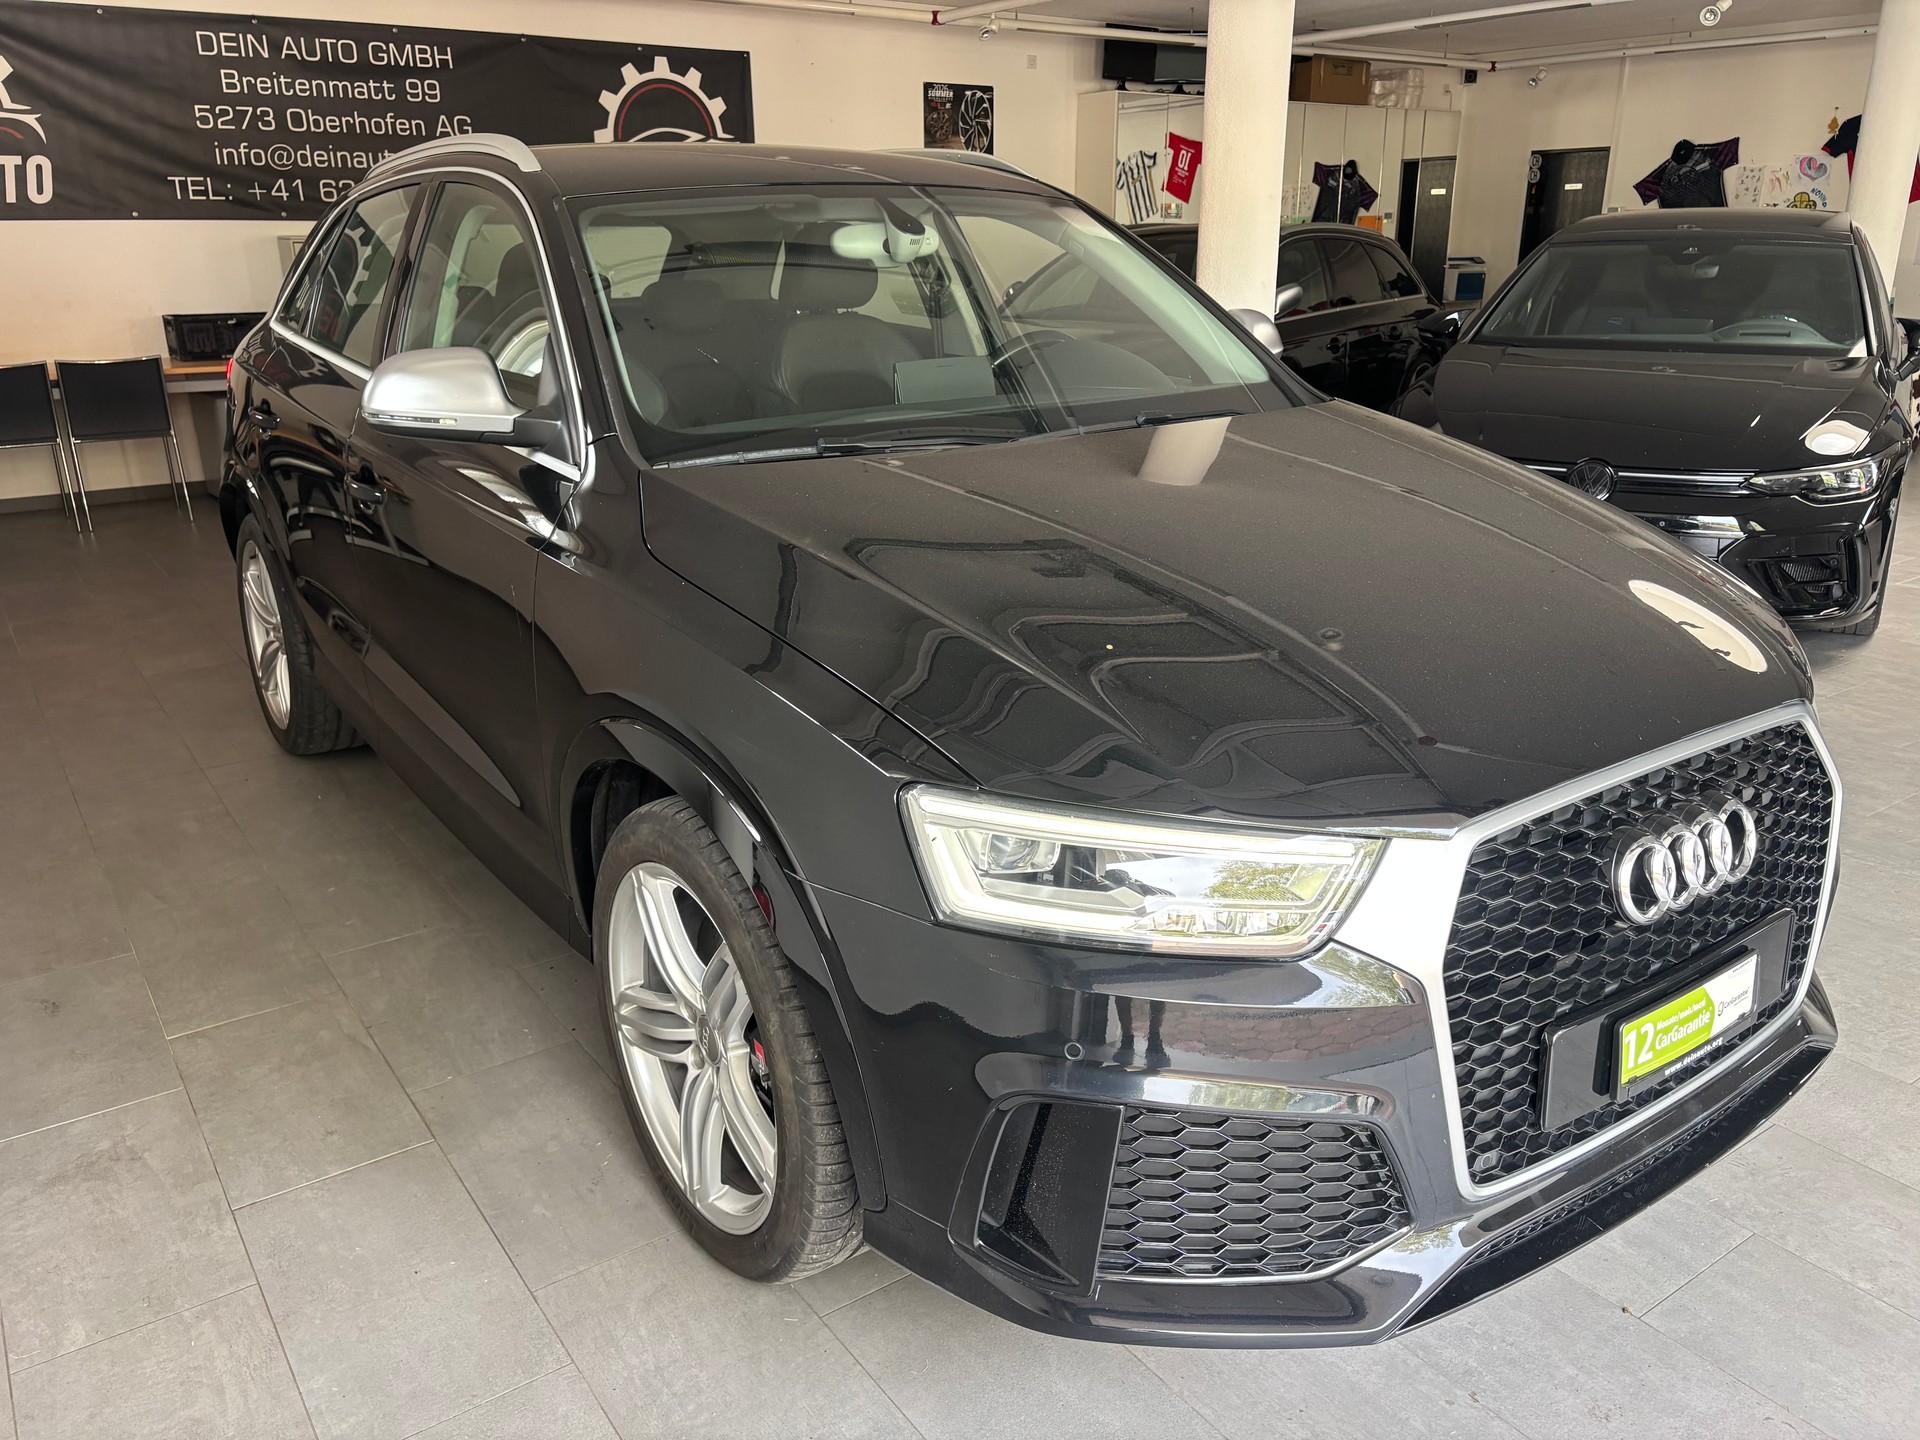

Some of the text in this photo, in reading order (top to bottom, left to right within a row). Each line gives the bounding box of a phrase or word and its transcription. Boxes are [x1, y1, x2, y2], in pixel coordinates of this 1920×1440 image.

[195, 31, 453, 69] DEIN AUTO GMBH
[220, 69, 441, 102] Breitenmatt 99
[194, 104, 473, 137] 5273 Oberhofen AG
[167, 176, 233, 200] TEL:
[248, 179, 304, 202] +41
[1624, 1022, 1655, 1070] 12
[1655, 1009, 1711, 1050] CarGarantie
